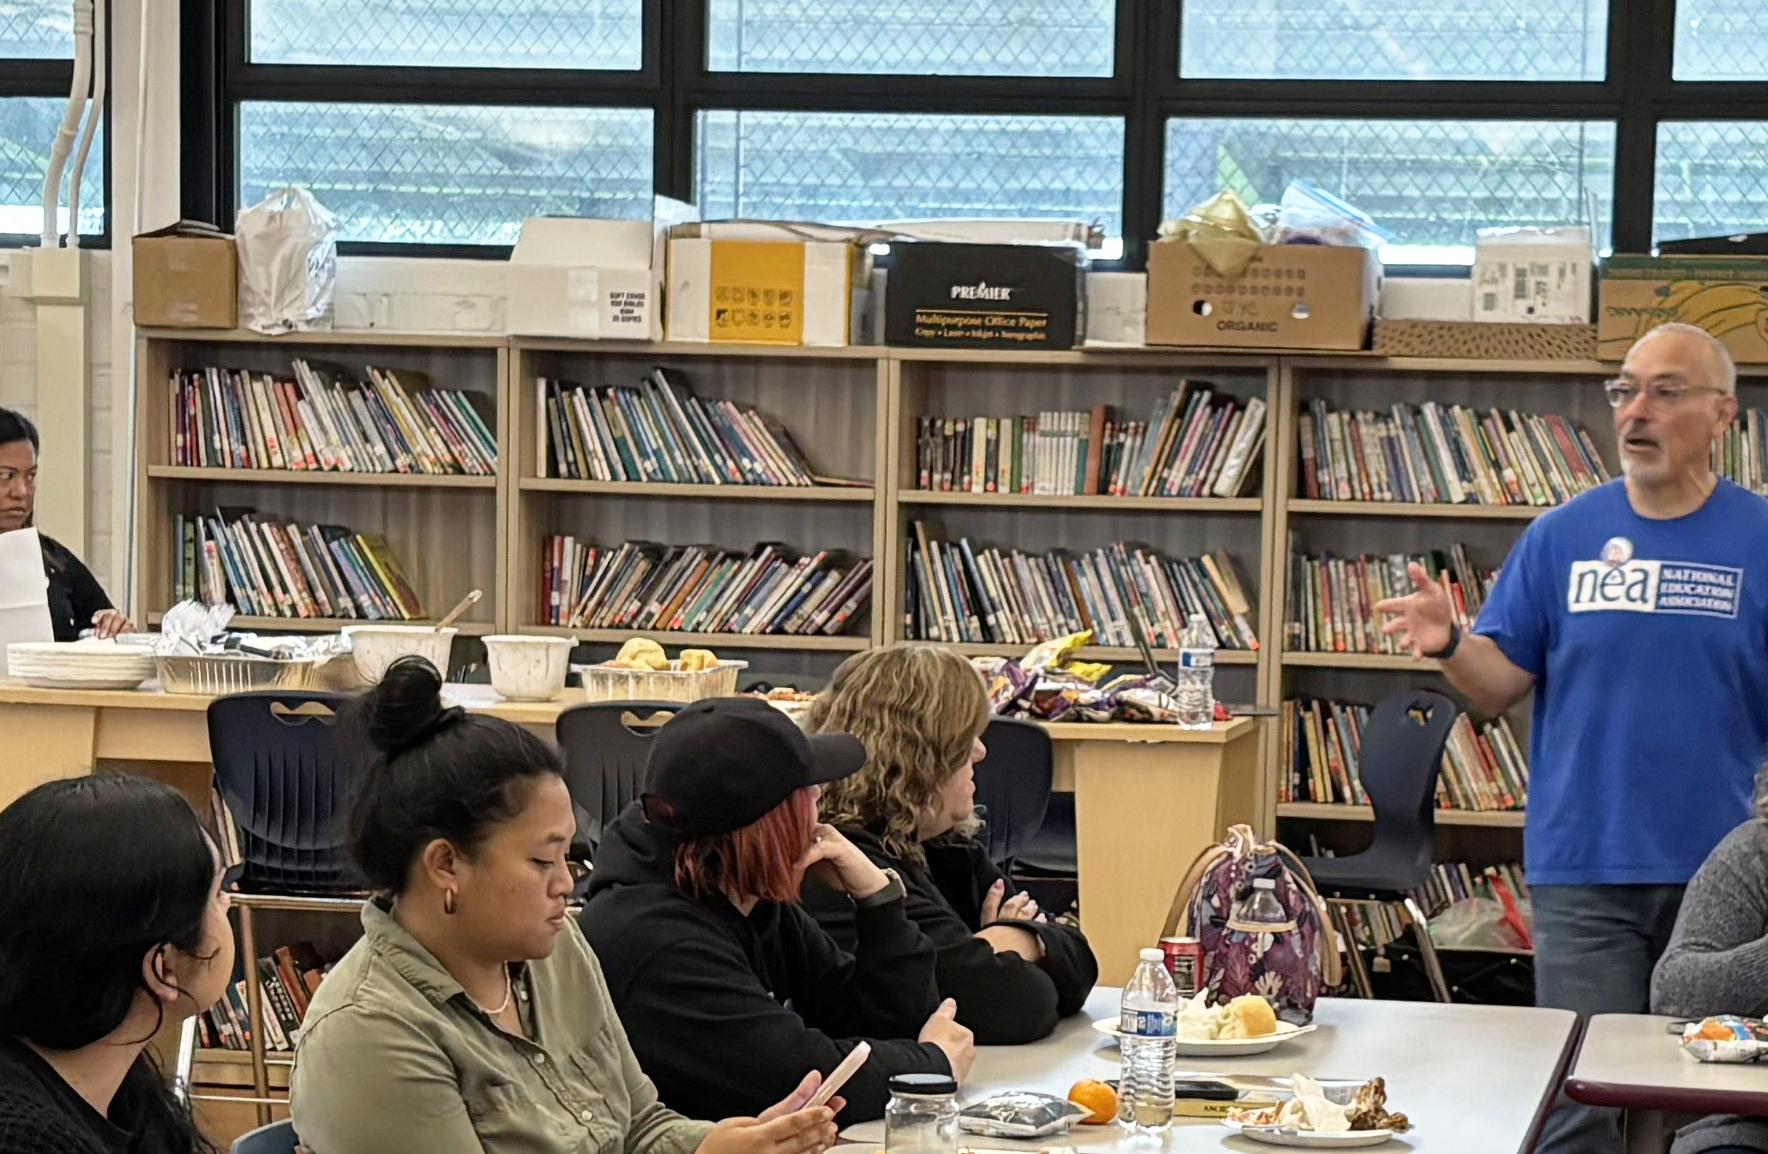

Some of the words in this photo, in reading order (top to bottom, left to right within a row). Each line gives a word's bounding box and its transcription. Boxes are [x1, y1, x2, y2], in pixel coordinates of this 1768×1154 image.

[951, 281, 1010, 300] PREMIER
[916, 314, 981, 327] Multipurpose
[985, 316, 1016, 327] Office
[1216, 320, 1279, 332] ORGANIC
[1573, 567, 1649, 604] nea
[1662, 569, 1736, 586] NATIONAL
